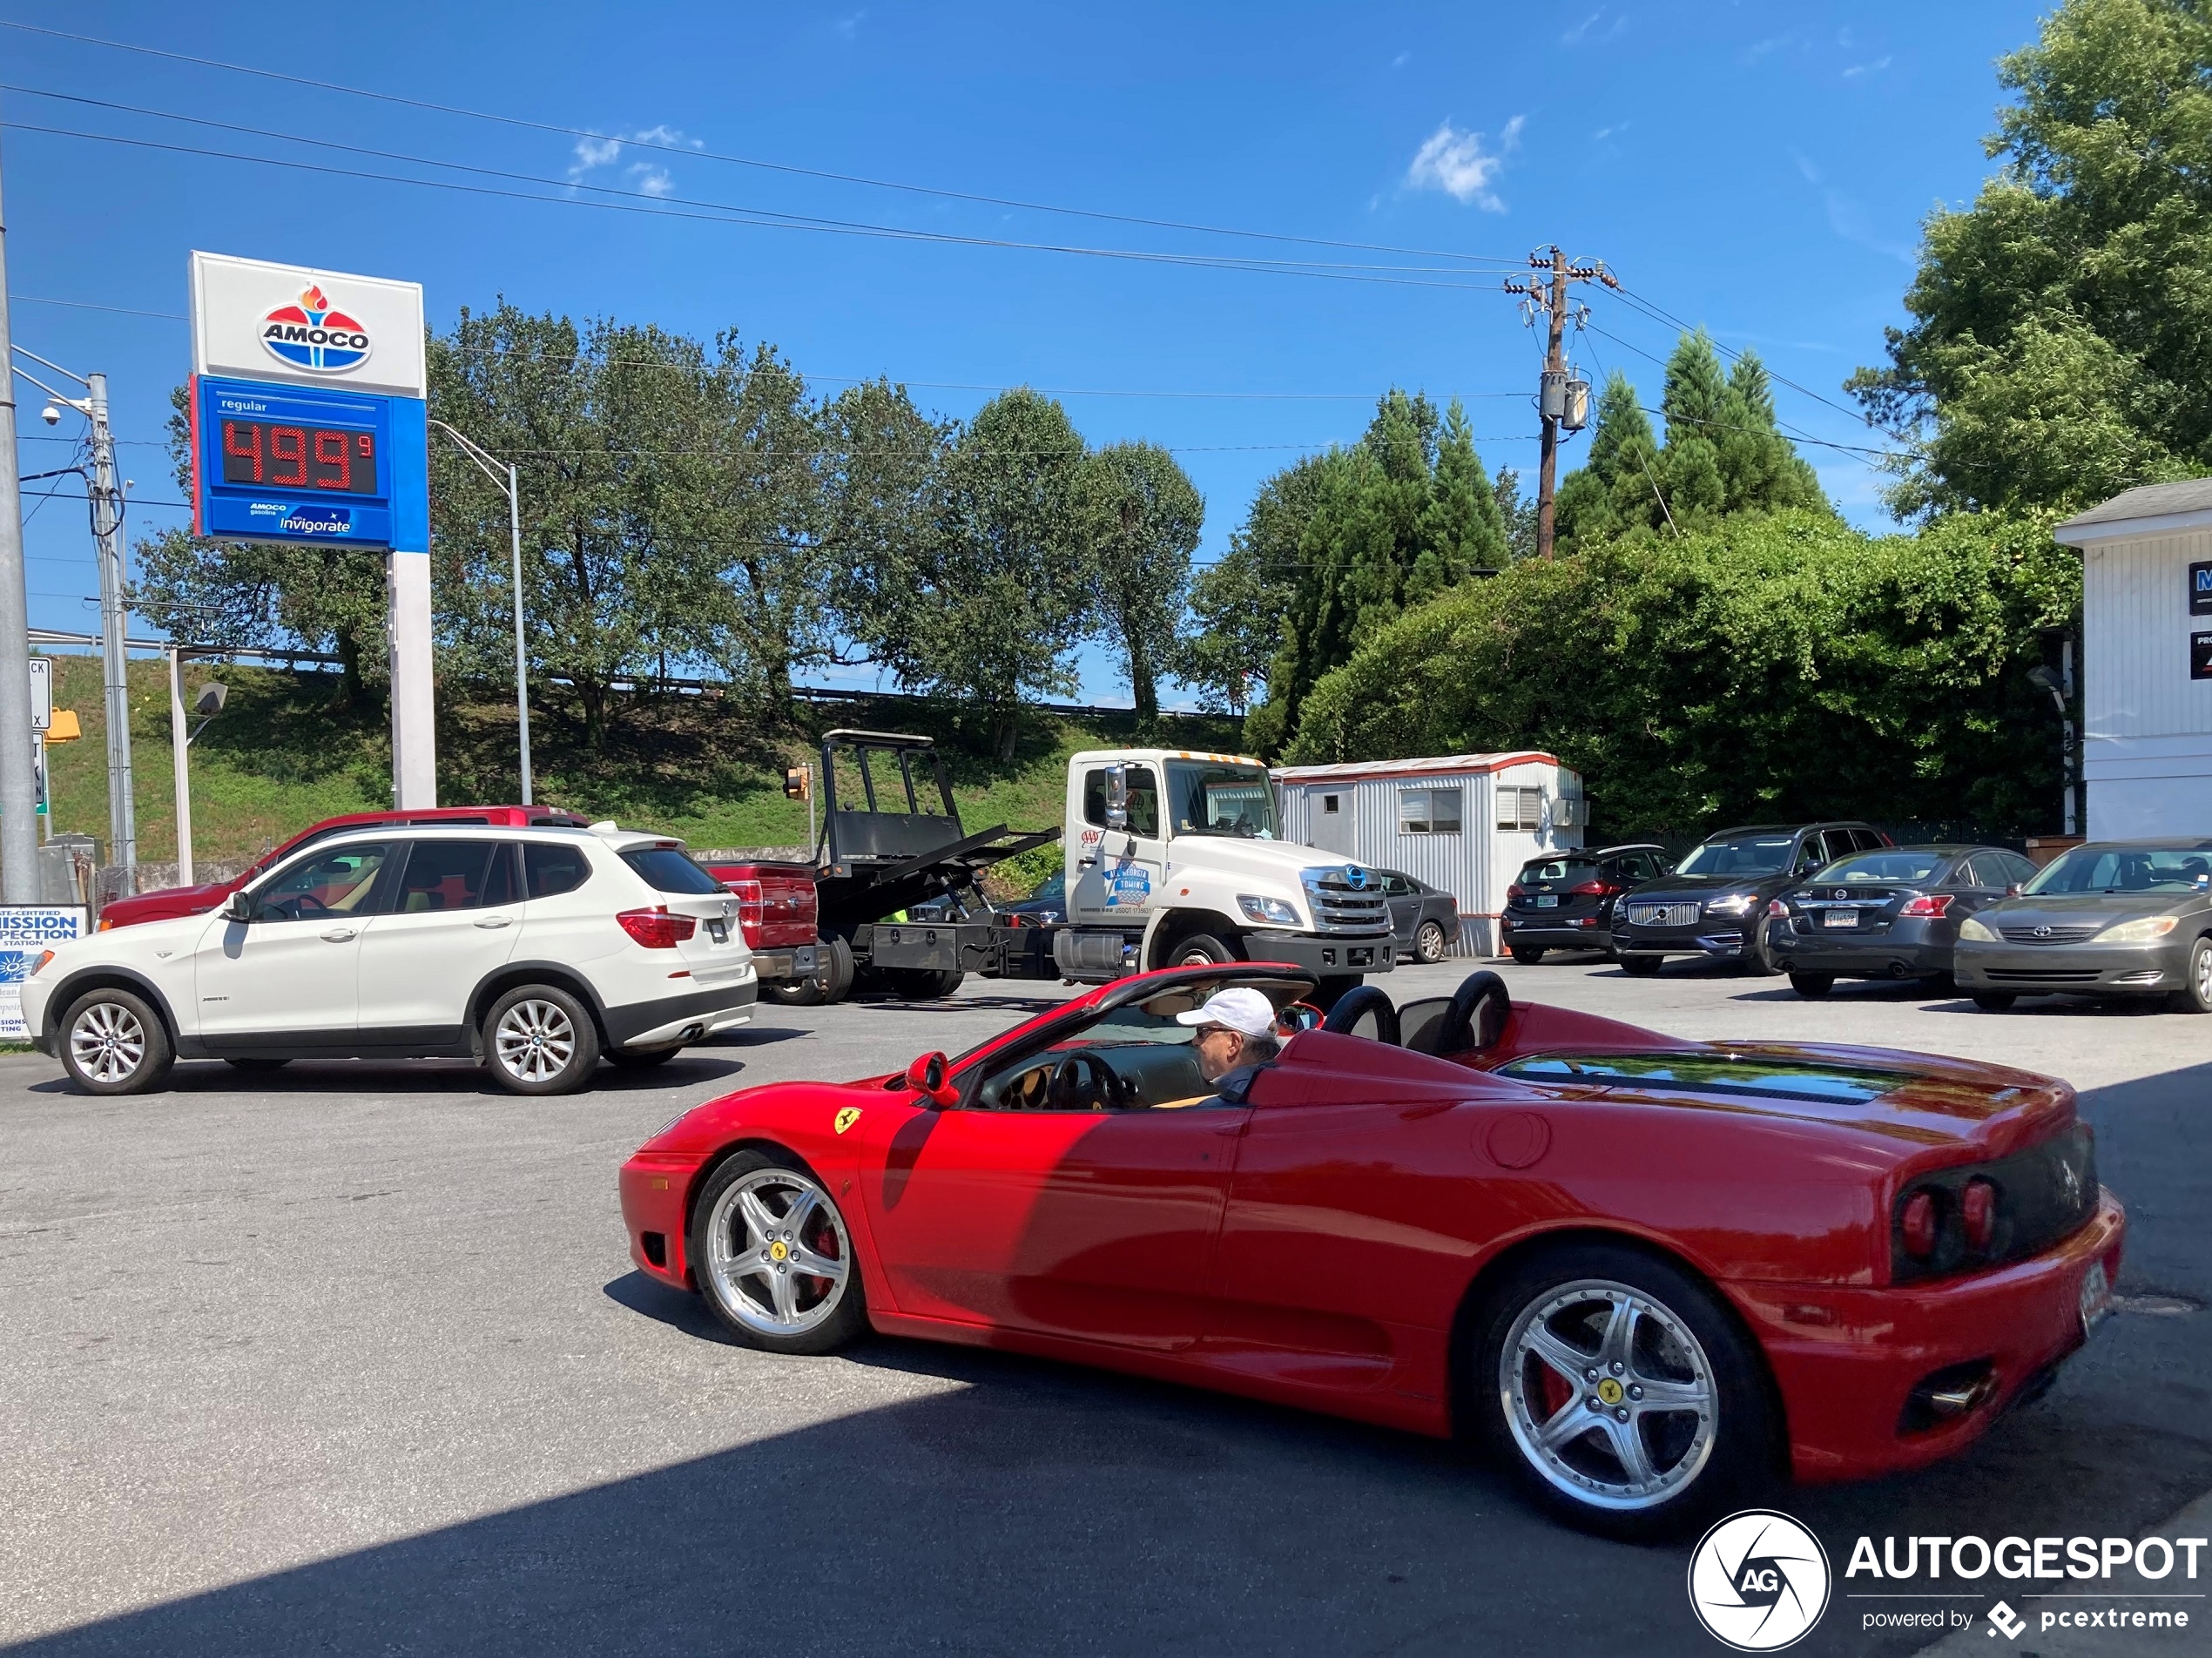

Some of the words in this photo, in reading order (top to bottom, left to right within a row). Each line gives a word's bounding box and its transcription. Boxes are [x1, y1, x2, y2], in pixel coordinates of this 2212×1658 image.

[263, 324, 369, 349] AMOCO
[221, 399, 267, 413] regular
[225, 422, 351, 489] 499
[280, 516, 351, 533] Invigorate
[1122, 867, 1146, 879] GEORGIA
[1121, 880, 1144, 890] TOWING
